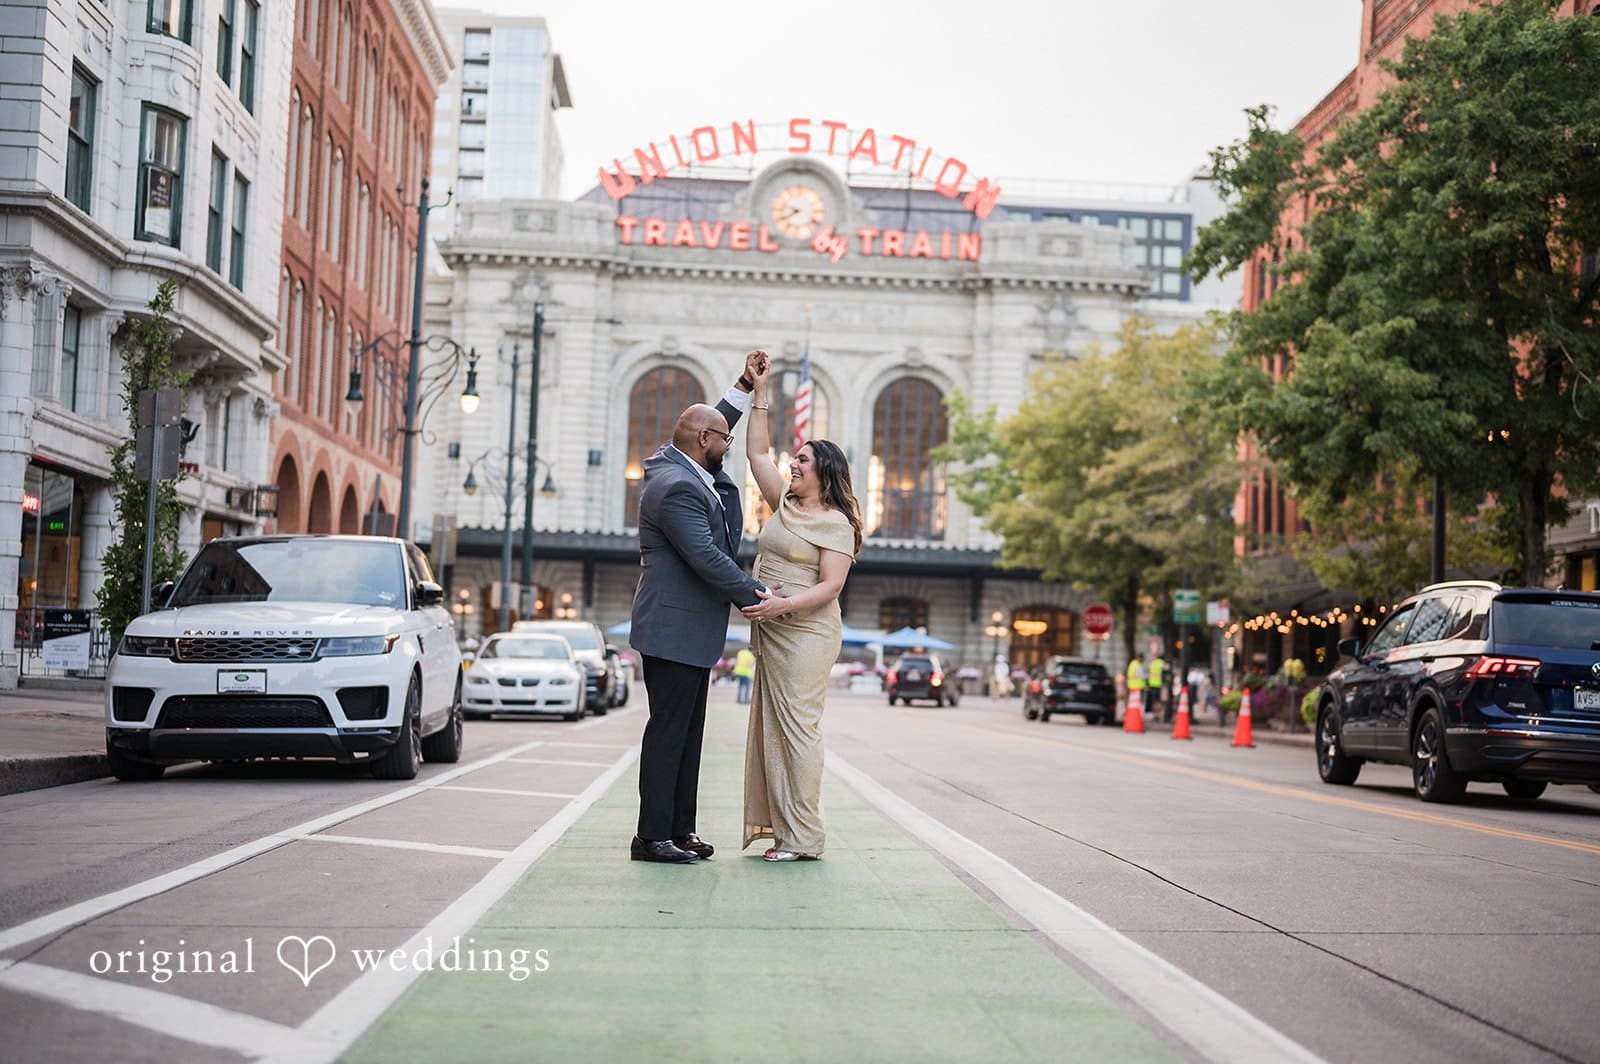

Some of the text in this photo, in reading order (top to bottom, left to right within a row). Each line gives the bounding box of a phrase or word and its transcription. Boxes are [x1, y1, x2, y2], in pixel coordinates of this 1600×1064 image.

[599, 117, 1002, 220] UNION STATION
[615, 216, 982, 263] TRAVEL by TRAIN
